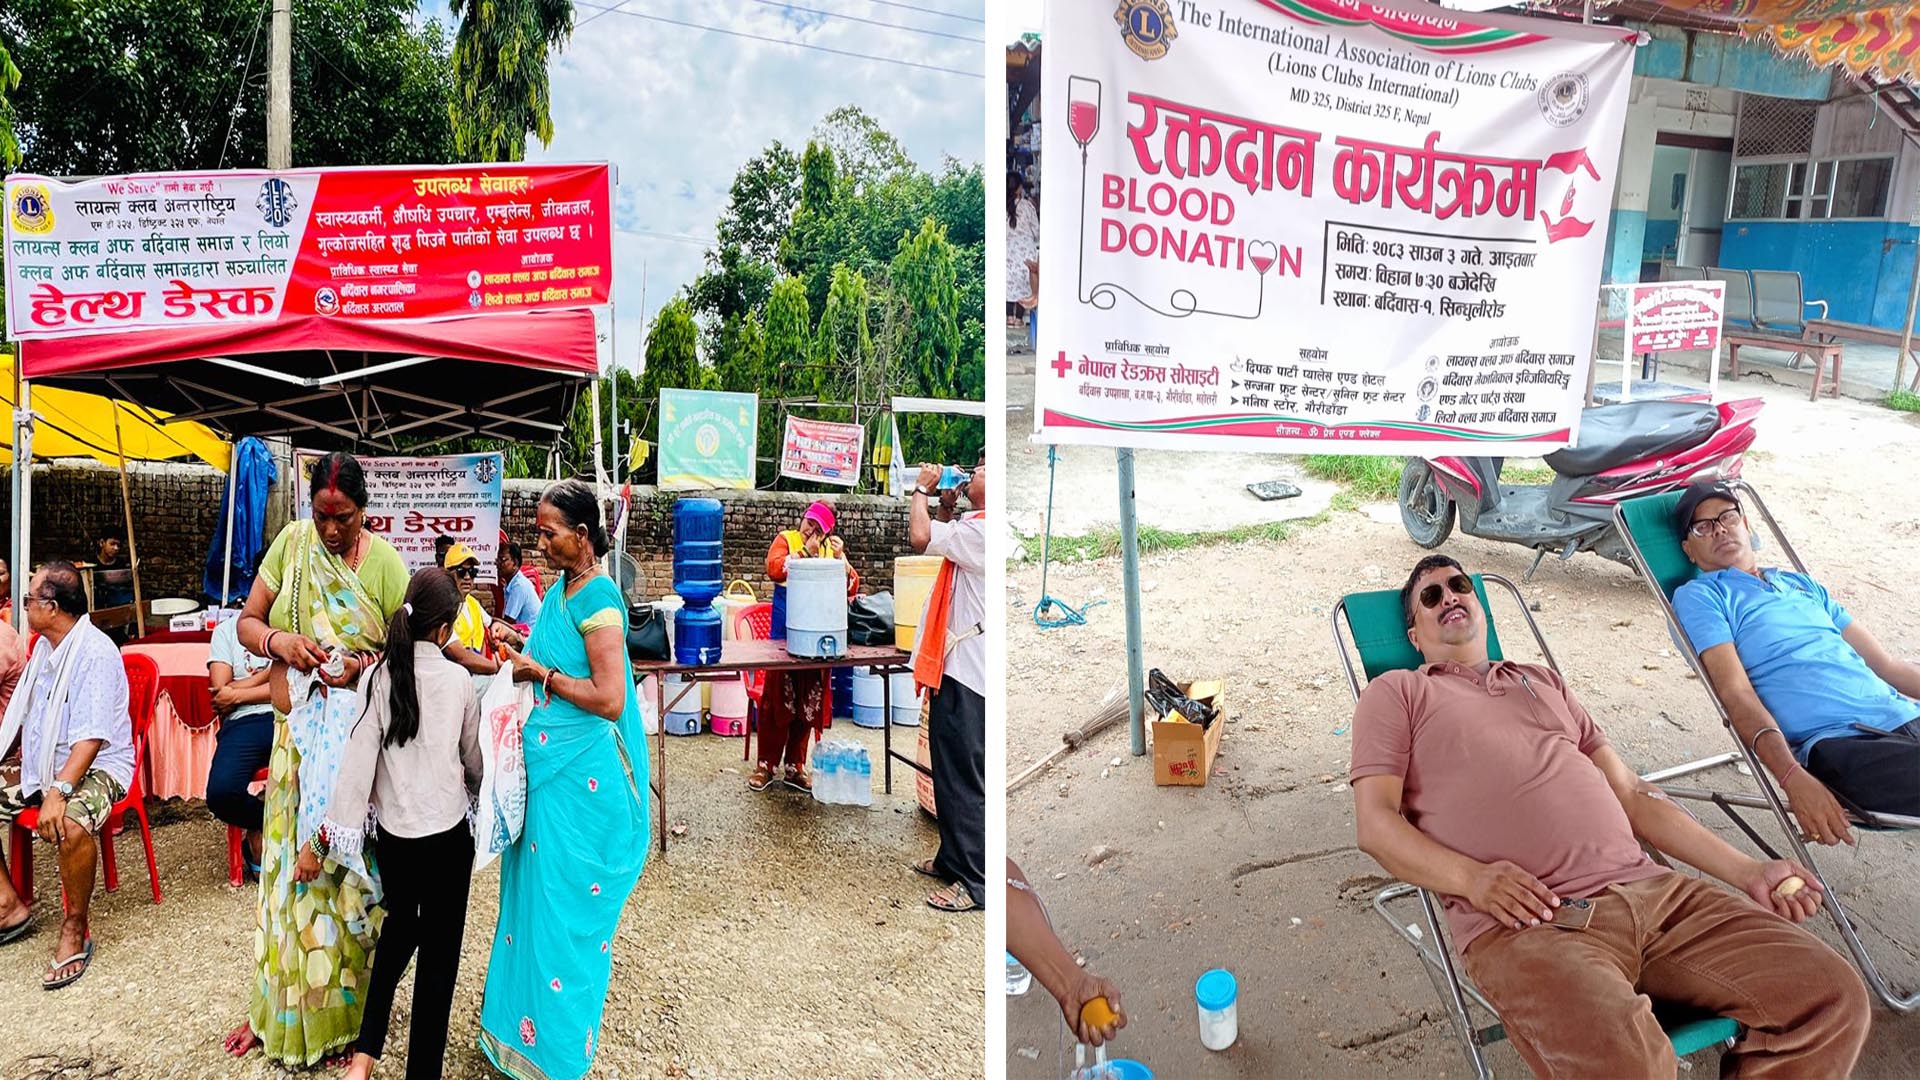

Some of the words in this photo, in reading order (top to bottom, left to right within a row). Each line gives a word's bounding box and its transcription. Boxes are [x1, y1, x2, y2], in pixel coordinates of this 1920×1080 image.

[1177, 0, 1212, 28] The
[1218, 9, 1331, 57] International
[1336, 38, 1430, 76] Association
[1435, 61, 1456, 80] of
[1455, 63, 1496, 88] Lions
[1500, 71, 1538, 92] Clubs
[1268, 51, 1316, 79] (Lions
[1321, 64, 1363, 89] Clubs
[1368, 77, 1460, 109] International)
[1290, 87, 1310, 104] MD
[1312, 90, 1332, 111] 325,
[1335, 99, 1372, 118] District
[1373, 104, 1392, 120] 325
[1393, 108, 1401, 125] F,
[1404, 109, 1432, 128] Nepal
[1127, 91, 1322, 198] रक्तदान
[1332, 130, 1543, 221] कार्यक्रम
[412, 177, 473, 198] उपलब्ध
[1101, 172, 1235, 226] BLOOD
[75, 200, 122, 217] लायन्स
[127, 199, 158, 215] क्लब
[164, 192, 236, 217] अन्तराष्ट्रिय
[272, 181, 283, 223] LEO
[393, 203, 433, 225] औषधि
[436, 206, 480, 225] उपचार,
[486, 200, 535, 225] एम्बुलेन्स,
[541, 197, 595, 218] जीवनजल,
[12, 240, 62, 257] लायन्स
[67, 240, 100, 257] क्लब
[106, 239, 136, 254] अफ
[141, 232, 191, 255] बर्दिवास
[196, 235, 235, 254] समाज
[241, 235, 252, 254] र
[257, 230, 290, 251] लियो
[390, 233, 412, 255] शुद्ध
[416, 228, 447, 248] पिउने
[451, 226, 491, 247] पानीको
[496, 226, 519, 246] सेवा
[522, 225, 566, 244] उपलब्ध
[569, 224, 582, 241] छ
[18, 264, 54, 281] क्लब
[61, 265, 90, 280] अफ
[96, 257, 147, 280] बर्दिवास
[152, 261, 220, 279] समाजद्वारा
[225, 253, 288, 277] सञ्चालित
[521, 252, 554, 265] आयोजक
[1373, 240, 1404, 260] २०८३
[1409, 243, 1444, 263] साउन
[1447, 248, 1456, 265] ३
[1460, 246, 1484, 266] गते,
[1489, 250, 1537, 270] आइतबार
[402, 261, 419, 276] सेवा
[1448, 271, 1497, 293] बजेदेखि
[29, 282, 147, 327] हेल्थ
[162, 279, 276, 319] डेस्क
[1440, 296, 1507, 322] सिन्धुलीरोड
[1105, 338, 1141, 353] प्राविधिक
[1144, 343, 1171, 356] सहयोग
[1299, 347, 1328, 361] सहयोग
[1489, 334, 1520, 349] आयोजक
[1078, 354, 1117, 379] नेपाल
[1120, 358, 1167, 383] रेडक्रस
[1170, 362, 1220, 388] सोसाइटी
[1246, 359, 1273, 375] दिपक
[1277, 365, 1299, 378] पार्टी
[1302, 368, 1332, 383] प्यालेस
[1337, 373, 1358, 386] एण्ड
[1362, 371, 1386, 386] होटल
[1446, 354, 1477, 368] लायन्स
[1498, 353, 1513, 366] अफ
[1548, 353, 1575, 367] समाज
[1474, 370, 1513, 385] मेकानिकल
[1244, 379, 1274, 393] सन्जना
[1383, 389, 1406, 403] सेन्टर
[1438, 394, 1457, 406] एण्ड
[1458, 391, 1478, 405] मोटर
[1503, 391, 1526, 405] संस्था
[1242, 394, 1268, 409] मनिष
[1273, 398, 1298, 414] स्टोर,
[1434, 409, 1456, 424] लियो
[1479, 411, 1495, 423] अफ
[1531, 411, 1557, 424] समाज
[374, 469, 400, 480] क्लब
[406, 467, 467, 482] अन्तराष्ट्रिय
[404, 510, 475, 534] डेस्क
